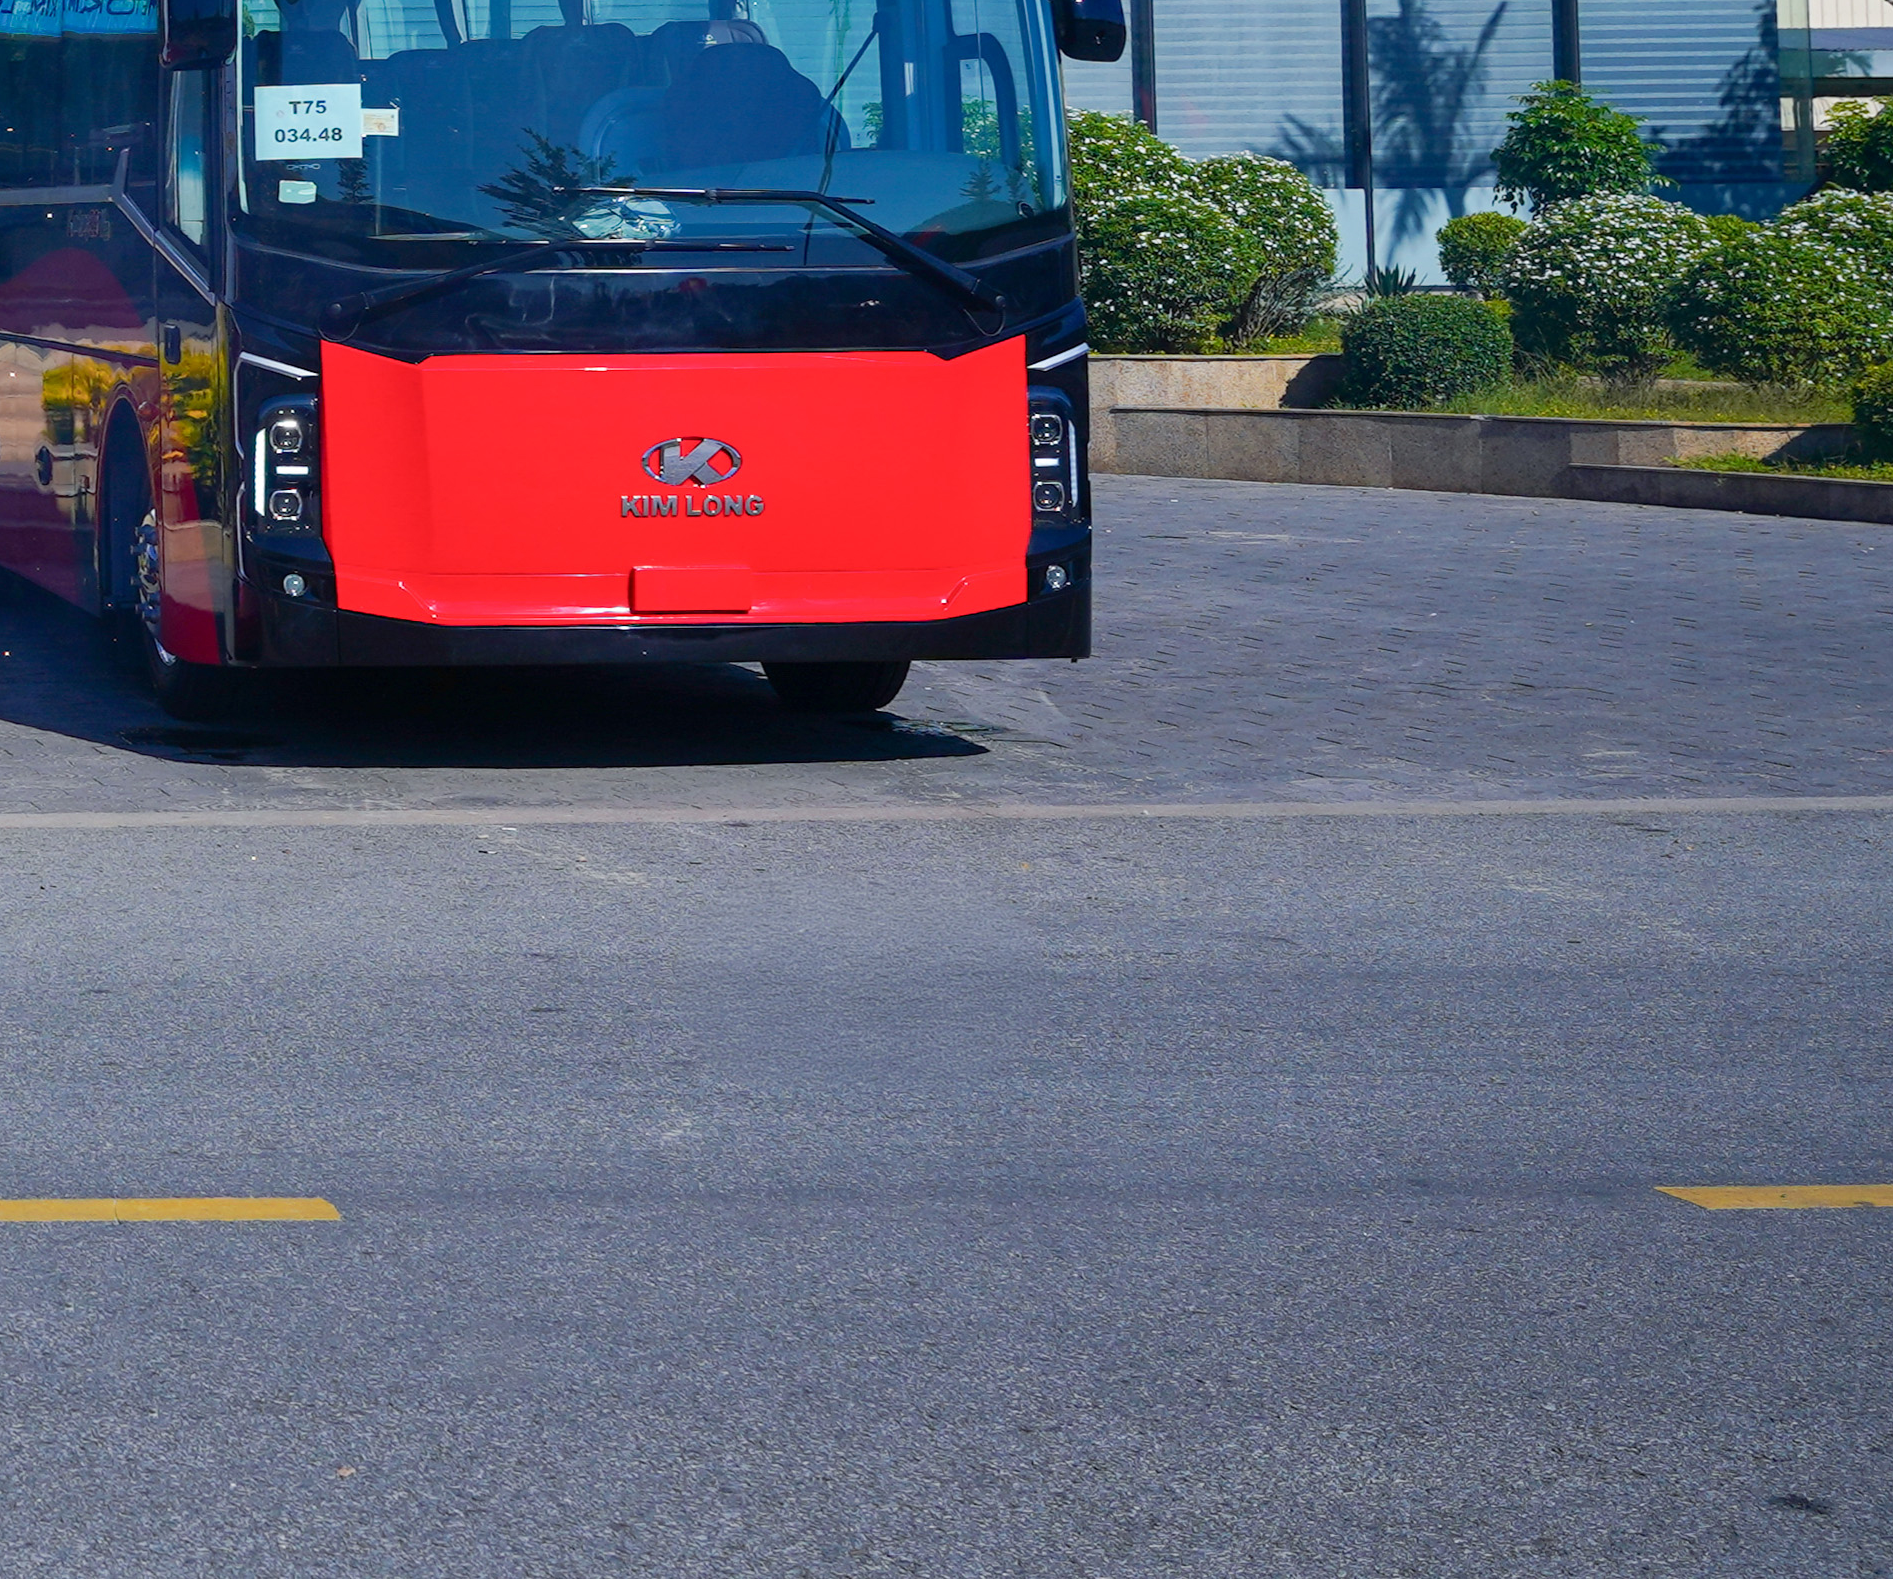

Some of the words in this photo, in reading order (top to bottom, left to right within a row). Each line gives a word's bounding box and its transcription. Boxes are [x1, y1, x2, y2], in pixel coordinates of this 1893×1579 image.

[288, 100, 327, 115] T75
[274, 127, 343, 143] 034.48
[620, 495, 679, 519] KIM
[685, 494, 765, 518] LONG
